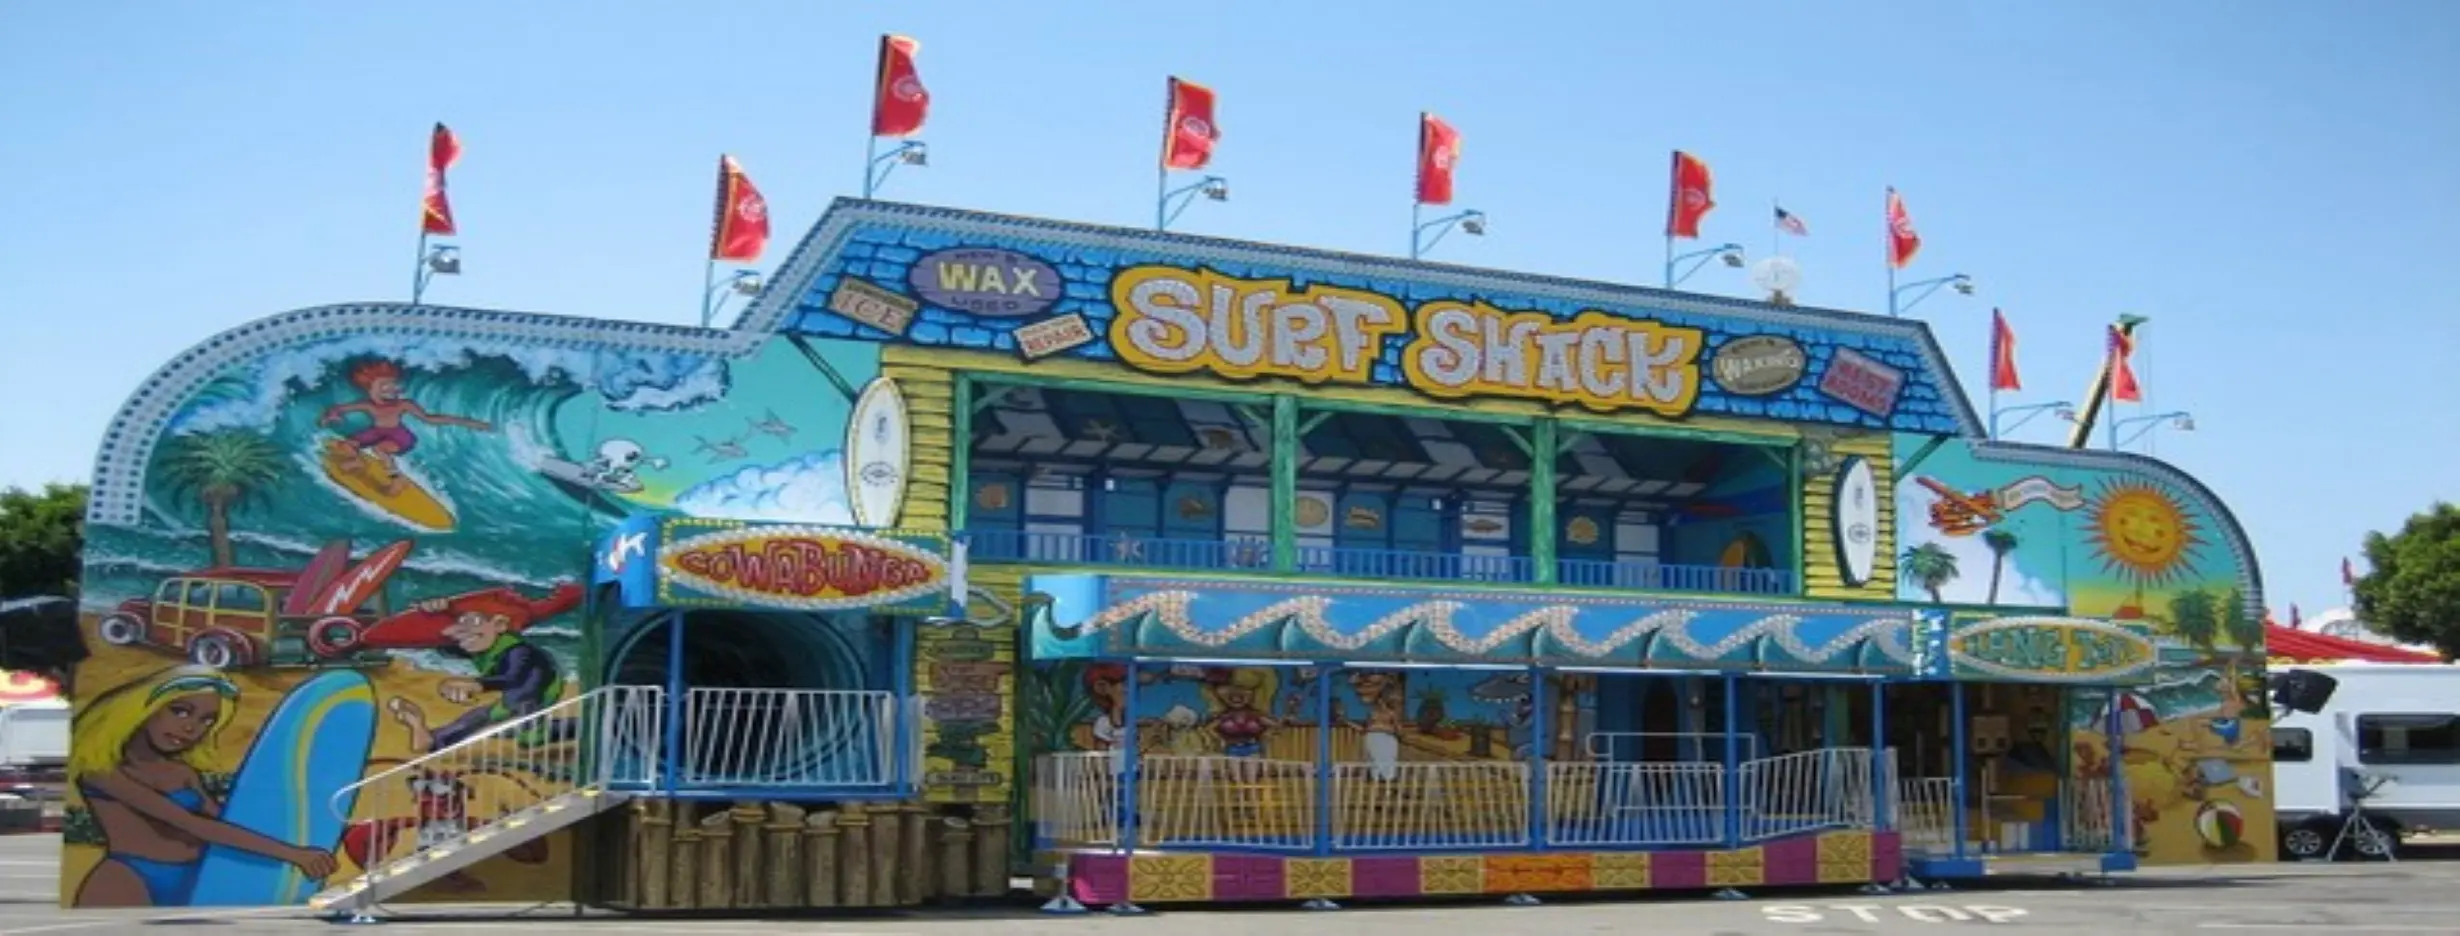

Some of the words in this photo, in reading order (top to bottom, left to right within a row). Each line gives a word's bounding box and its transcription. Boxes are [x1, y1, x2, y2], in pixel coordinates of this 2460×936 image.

[938, 261, 1041, 298] WAX
[1127, 277, 1393, 373] SURF
[1419, 308, 1684, 403] SHACK
[677, 539, 930, 597] COWABUNGA
[1761, 904, 2029, 923] STOP
